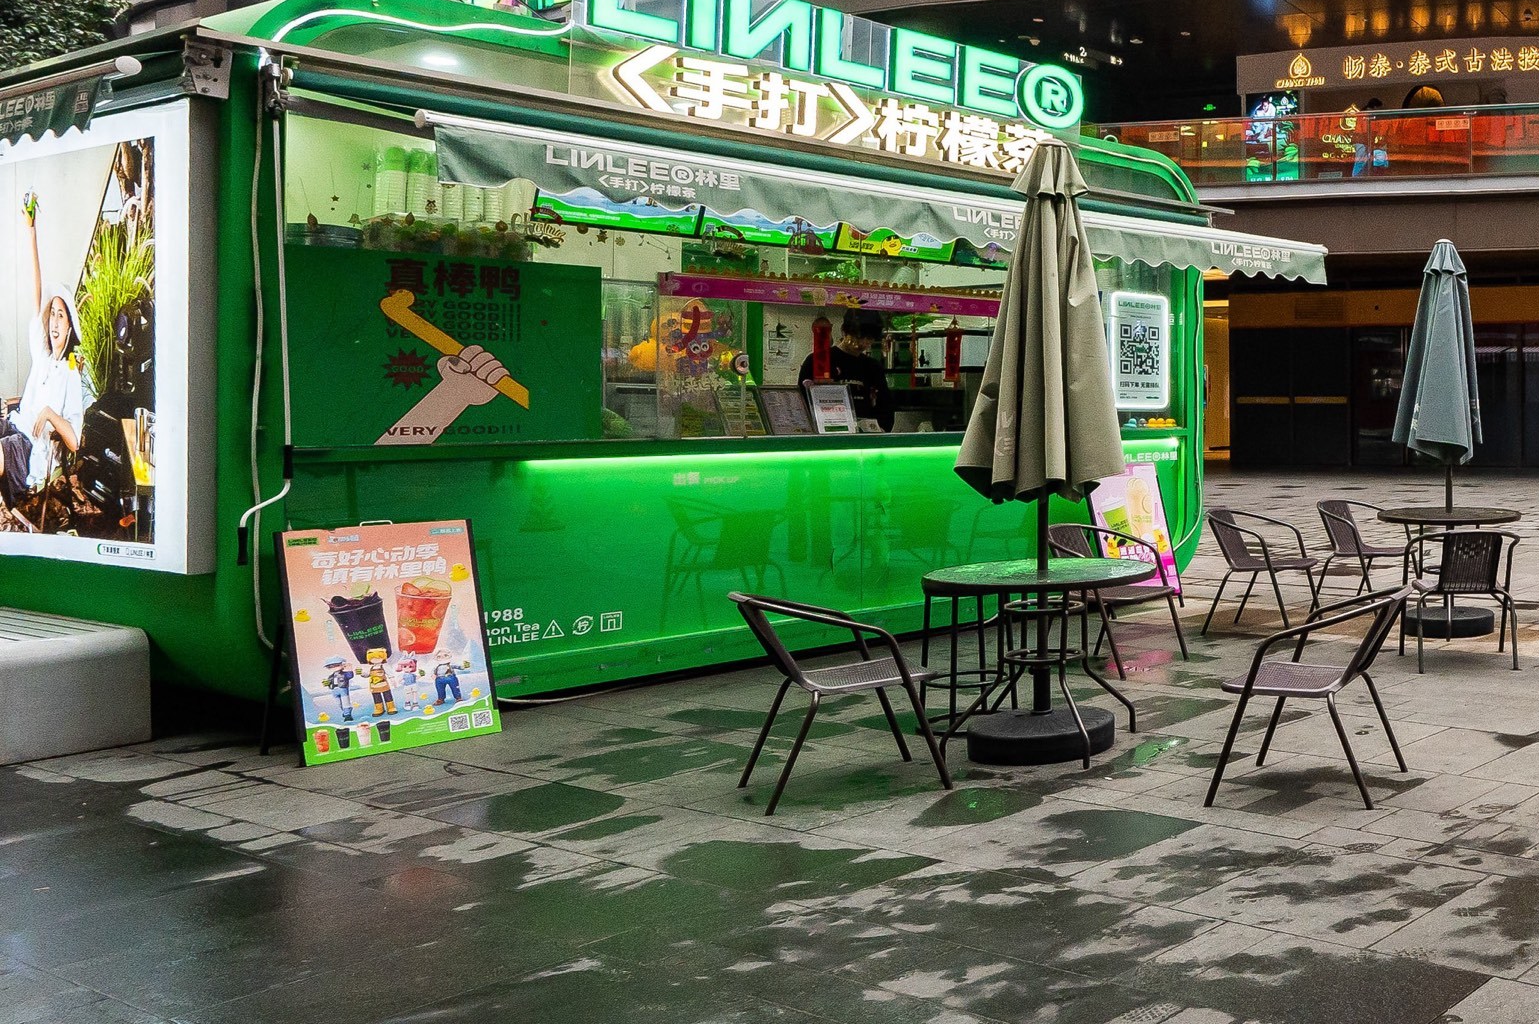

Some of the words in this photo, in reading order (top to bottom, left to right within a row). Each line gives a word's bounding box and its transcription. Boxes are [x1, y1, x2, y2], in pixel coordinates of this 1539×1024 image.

[1306, 77, 1325, 88] THAI
[385, 258, 521, 302] 真棒鸭
[387, 426, 438, 437] VERY
[484, 607, 524, 624] 1988
[514, 622, 540, 633] Tea
[488, 631, 540, 647] LINLEE
